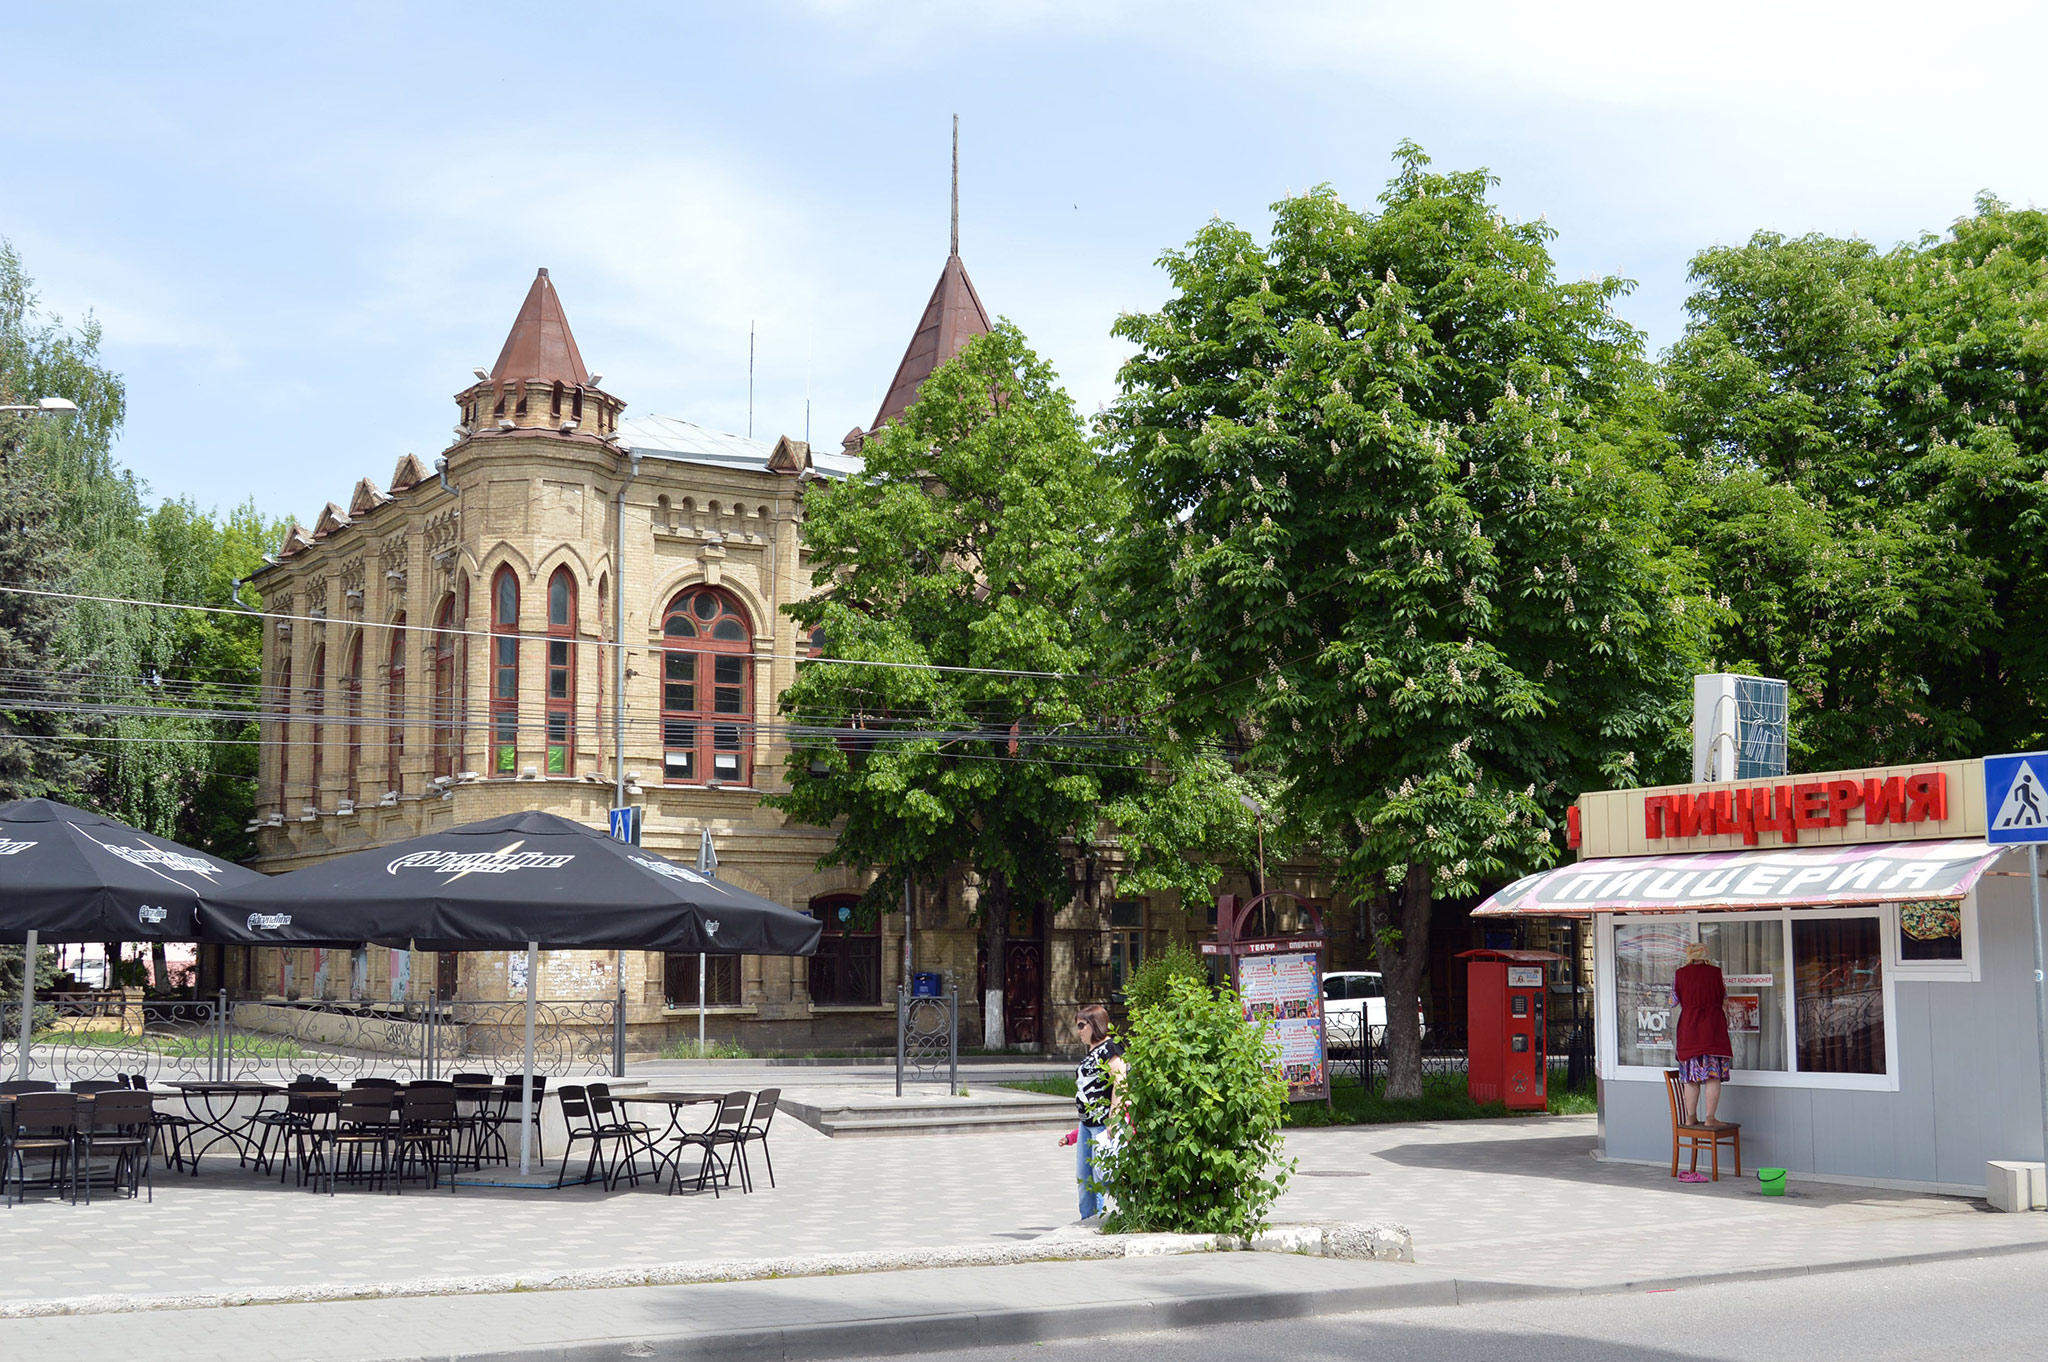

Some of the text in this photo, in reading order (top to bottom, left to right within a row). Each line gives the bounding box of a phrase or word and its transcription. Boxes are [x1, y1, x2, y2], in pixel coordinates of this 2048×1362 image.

[1645, 772, 1948, 845] ПИЦЦЕРИЯ
[387, 850, 575, 876] Adrenaline
[1553, 861, 1947, 900] ПИЦЦЕРИЯ
[1249, 943, 1275, 952] ТЕАТР
[1638, 1011, 1670, 1031] МОТ
